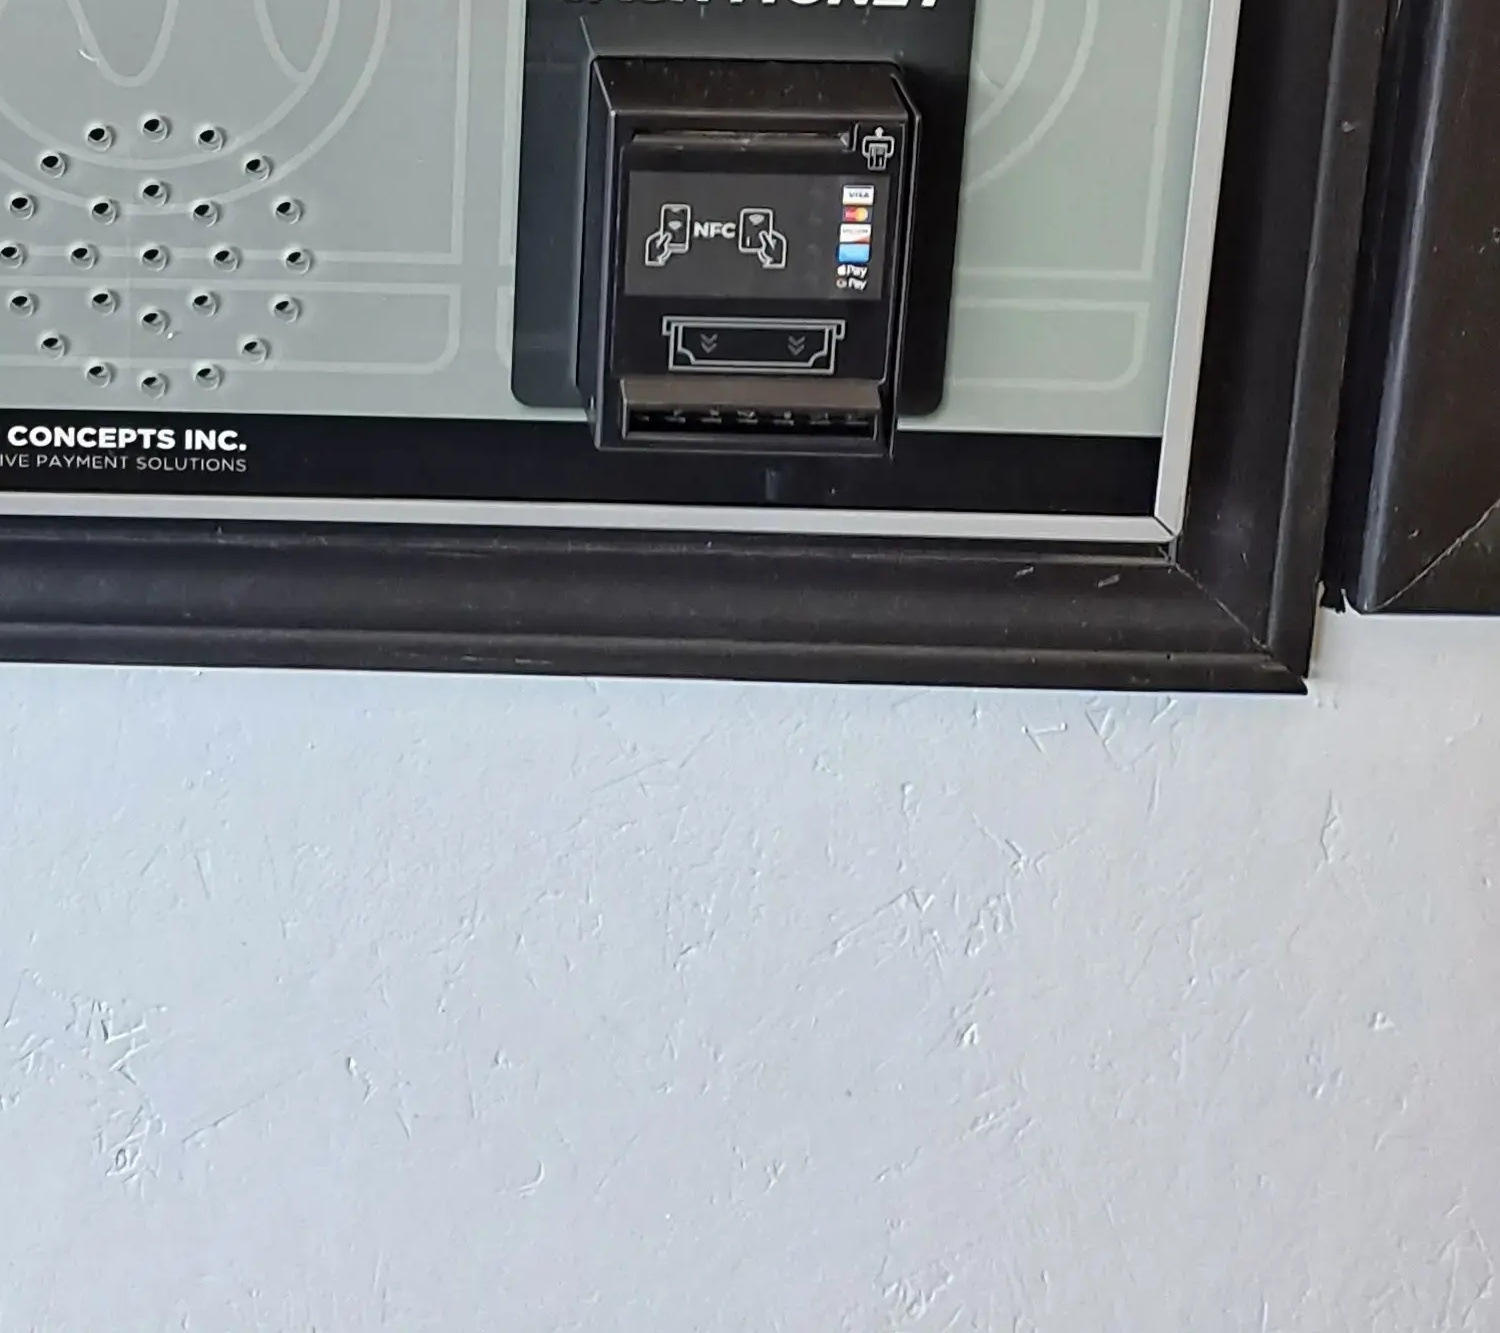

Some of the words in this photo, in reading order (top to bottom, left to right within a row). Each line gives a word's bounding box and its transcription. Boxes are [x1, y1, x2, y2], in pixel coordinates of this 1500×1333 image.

[693, 221, 737, 239] NFC
[846, 264, 868, 278] Pay
[7, 425, 176, 450] CONCEPTS
[184, 429, 247, 452] INC.
[36, 454, 129, 470] PAYMENT
[136, 456, 247, 473] SOLUTIONS
